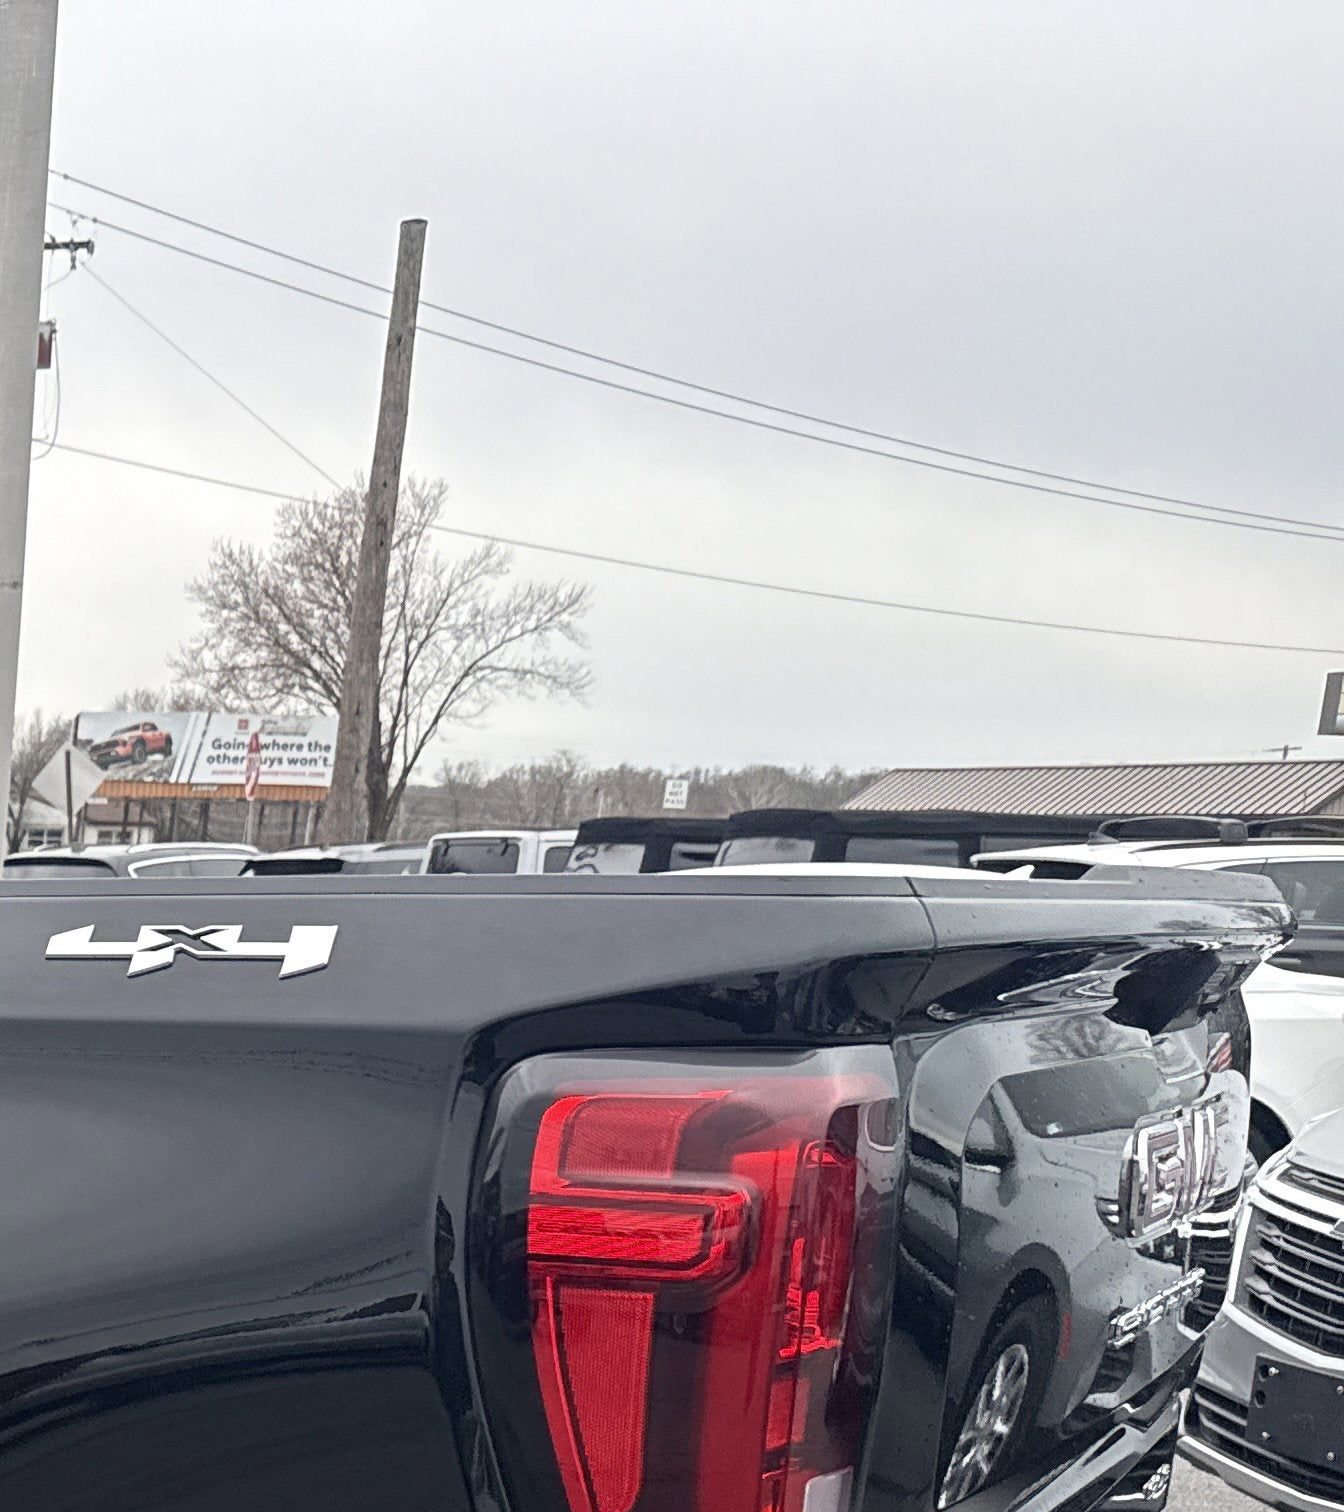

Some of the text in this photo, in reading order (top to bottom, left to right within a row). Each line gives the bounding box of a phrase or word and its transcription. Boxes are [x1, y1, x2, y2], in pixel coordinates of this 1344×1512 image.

[212, 738, 332, 753] Goin where the
[207, 752, 245, 764] other
[256, 756, 283, 769] uys
